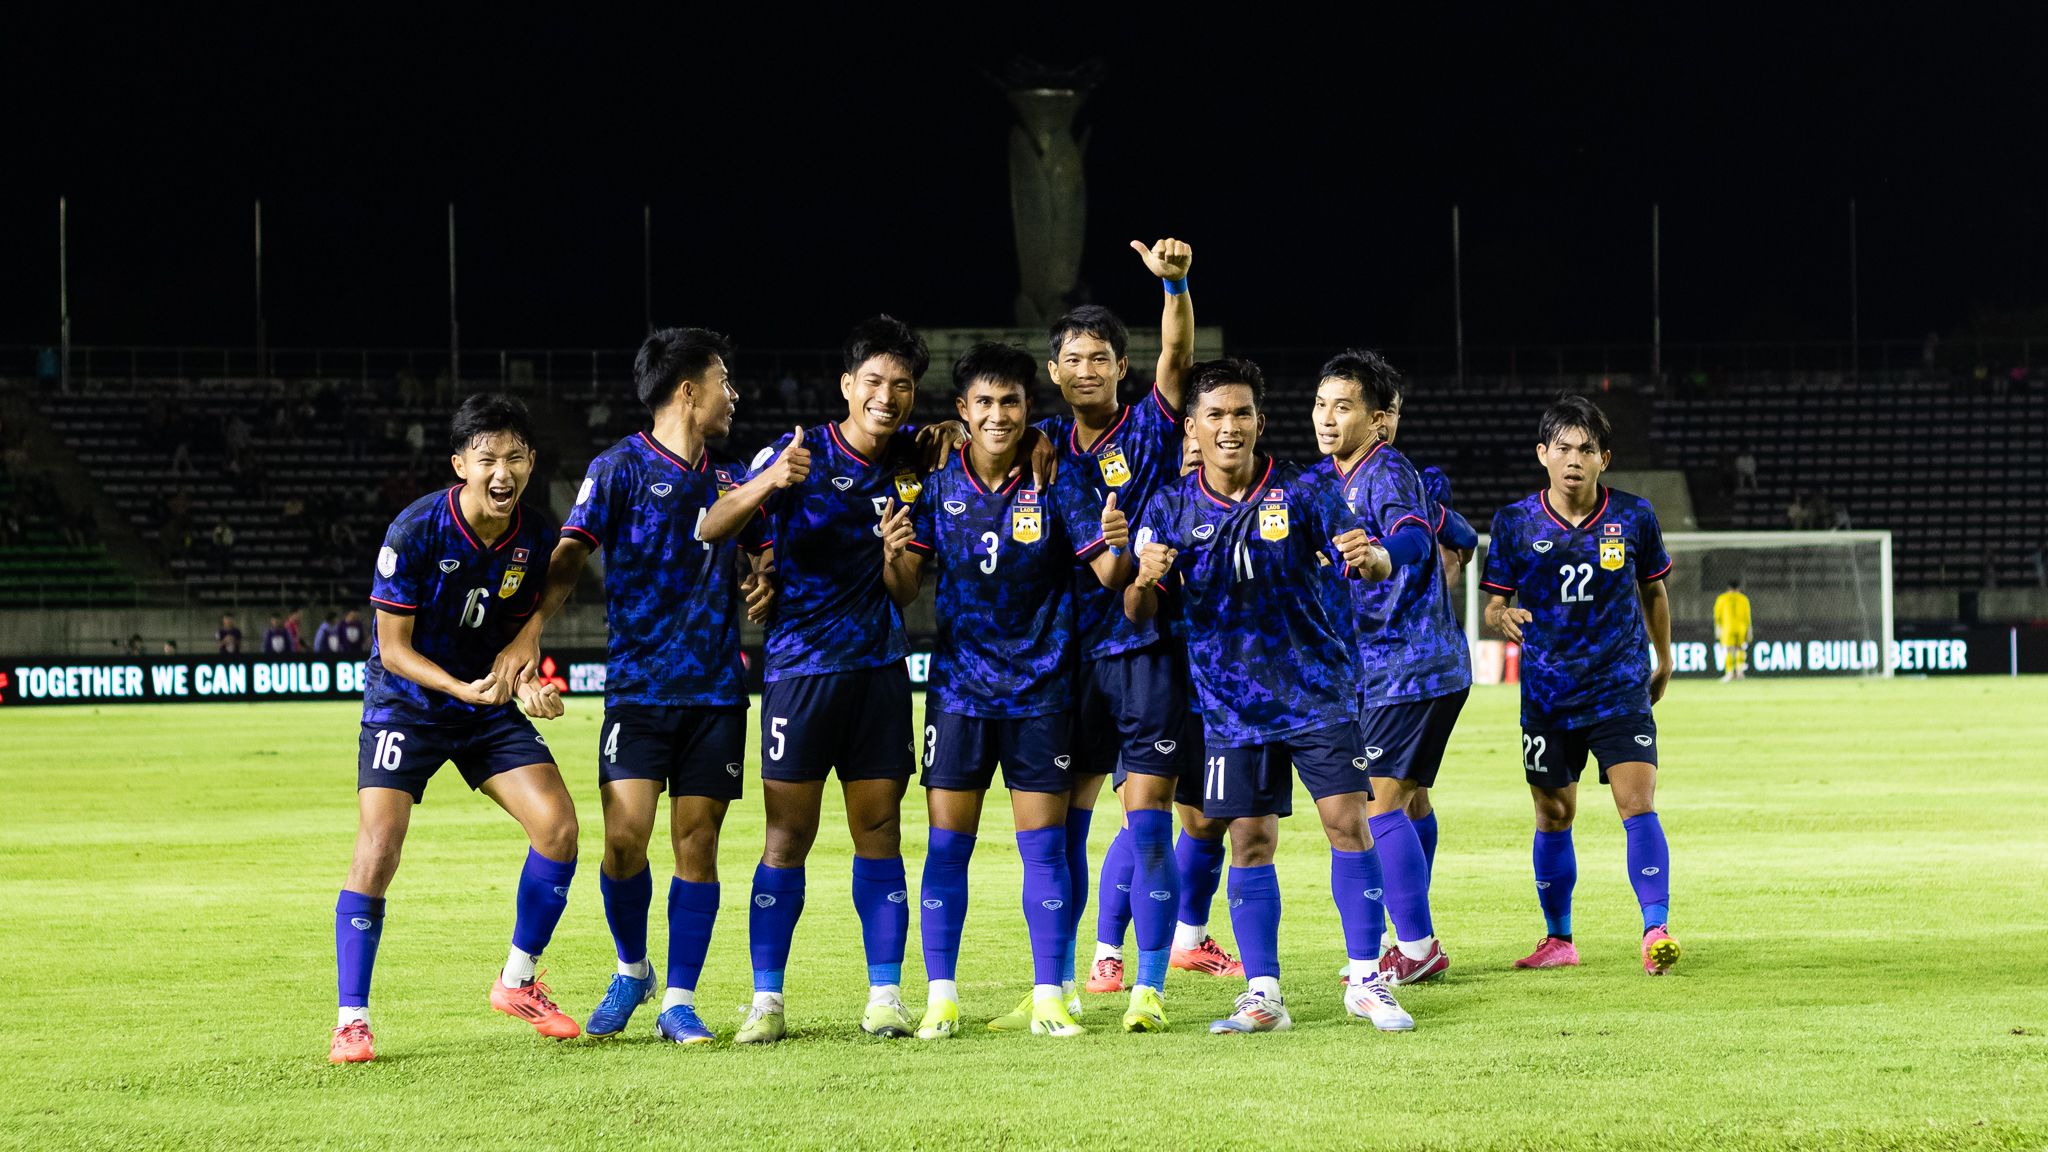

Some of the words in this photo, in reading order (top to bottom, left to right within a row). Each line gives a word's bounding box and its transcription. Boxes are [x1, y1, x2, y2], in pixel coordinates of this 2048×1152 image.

[1103, 450, 1116, 459] LAOS
[871, 496, 888, 538] 5
[980, 531, 999, 575] 3
[1233, 540, 1254, 583] 11
[1559, 563, 1594, 603] 22
[459, 587, 490, 628] 16
[1753, 641, 1802, 671] CAN
[1807, 640, 1879, 670] BUILD
[1890, 639, 1968, 669] BETTER
[15, 666, 144, 698] TOGETHER
[151, 665, 189, 696] WE
[195, 664, 247, 695] CAN
[253, 662, 330, 693] BUILD
[336, 661, 366, 693] BE
[569, 677, 605, 692] ELEC
[372, 729, 405, 771] 16
[604, 722, 621, 764] 4
[768, 716, 788, 761] 5
[924, 724, 937, 767] 3
[1523, 733, 1548, 773] 22
[1205, 756, 1225, 800] 11
